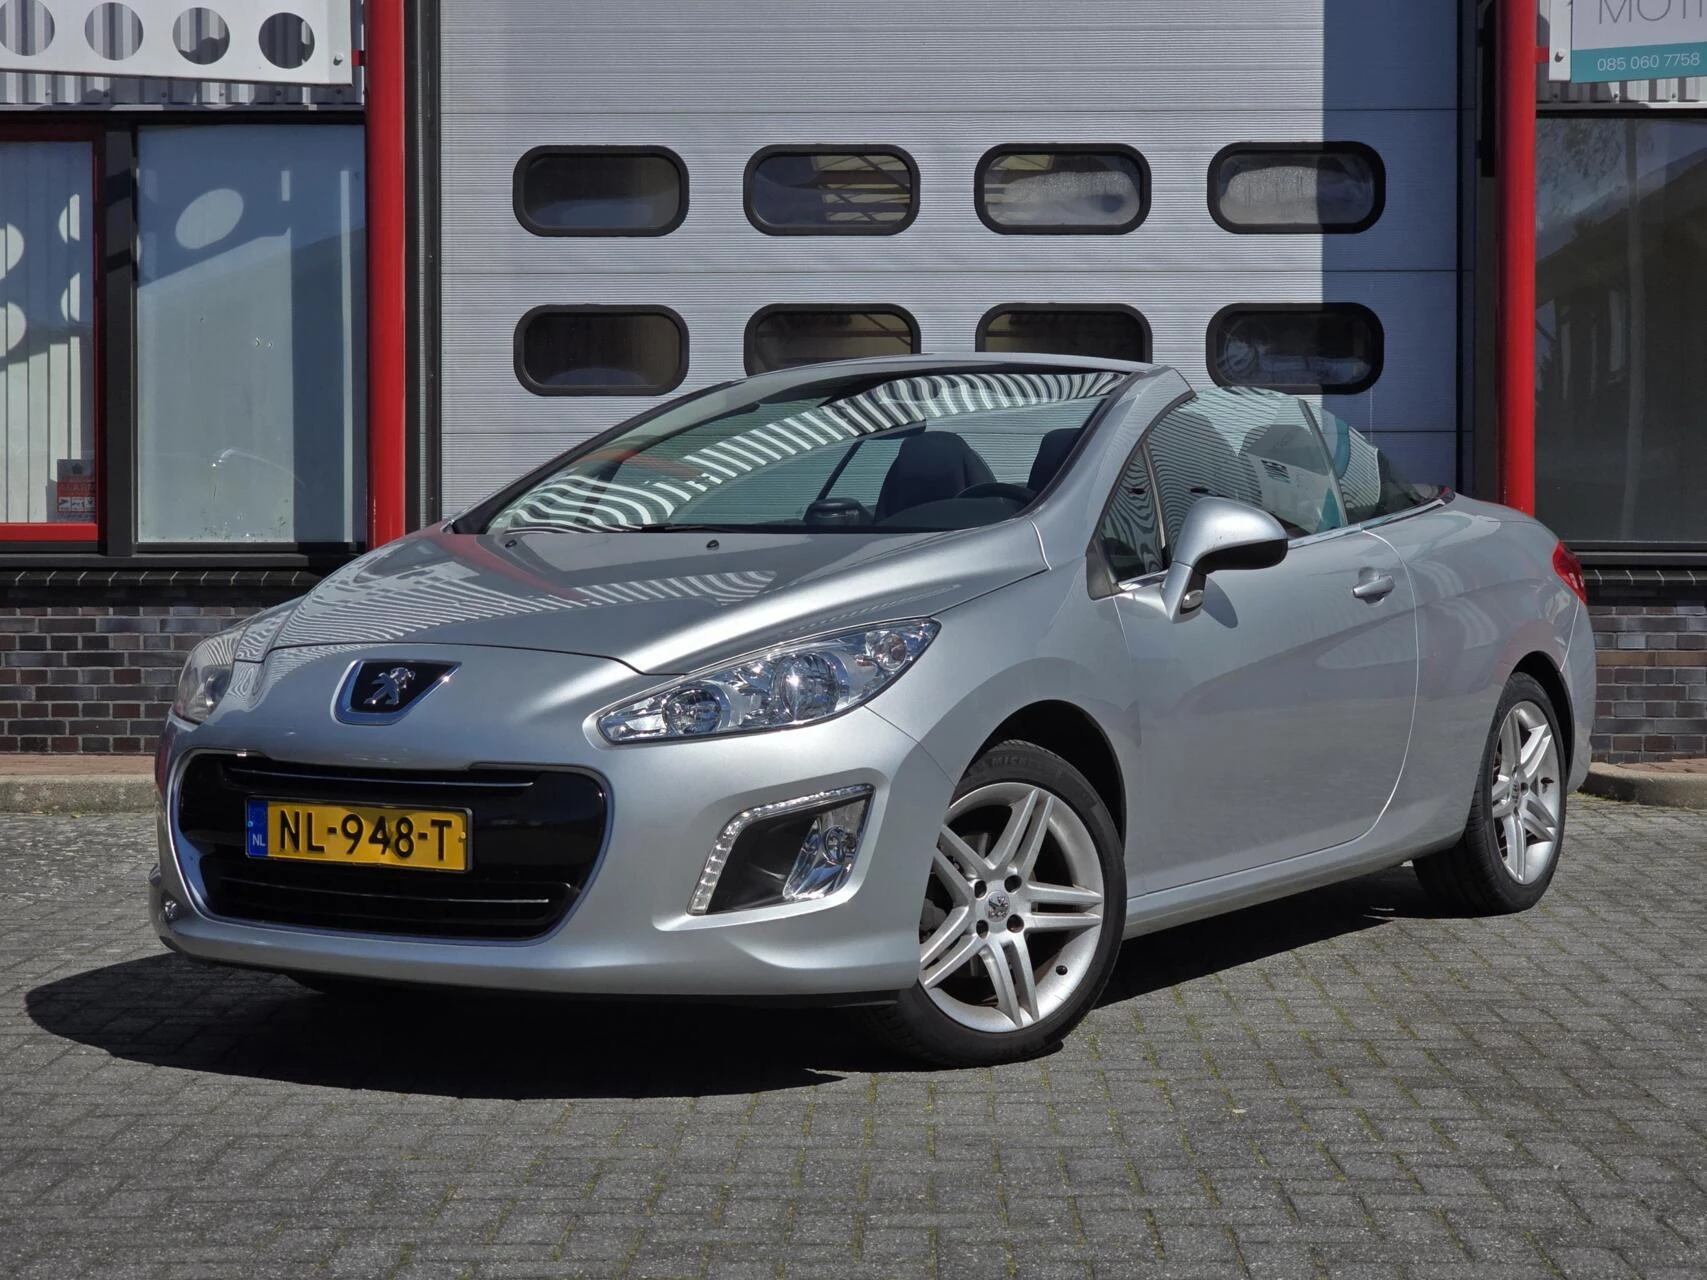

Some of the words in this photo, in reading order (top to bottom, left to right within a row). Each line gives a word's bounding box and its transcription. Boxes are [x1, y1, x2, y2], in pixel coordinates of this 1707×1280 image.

[1597, 57, 1626, 72] 085
[1630, 54, 1659, 69] 060
[1664, 52, 1700, 66] 7758
[252, 833, 266, 847] NL
[280, 810, 452, 861] NL-948-T
